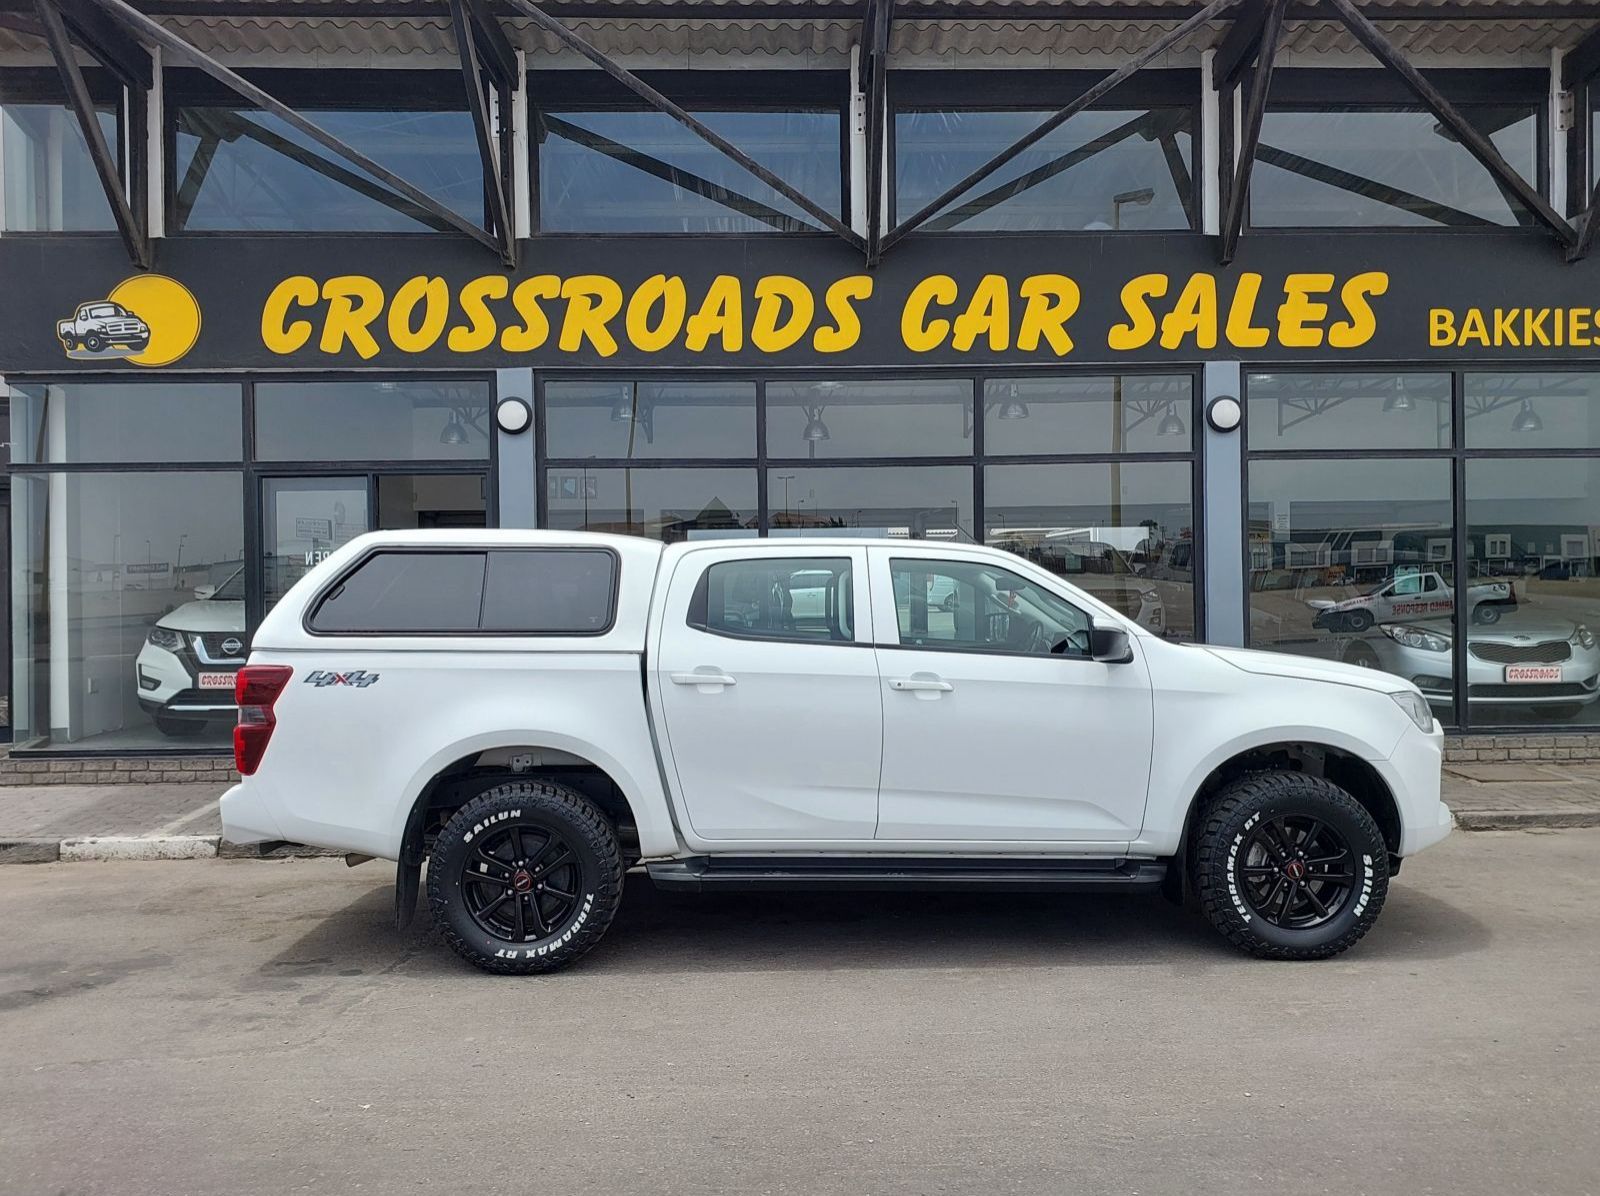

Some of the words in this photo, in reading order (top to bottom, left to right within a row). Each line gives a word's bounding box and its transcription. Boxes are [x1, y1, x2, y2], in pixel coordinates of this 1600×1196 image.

[262, 274, 874, 359] CROSSROADS
[901, 274, 1081, 357] CAR
[1108, 272, 1389, 351] SALES
[1429, 308, 1600, 347] BAKKIE
[1508, 668, 1560, 679] CROSSROADS
[463, 809, 521, 843] SAILUN
[1226, 833, 1252, 924] TERRAMAX
[1244, 811, 1260, 831] RT
[1353, 854, 1374, 918] SAILUN
[525, 893, 594, 958] TERRAMAX
[495, 948, 518, 959] RT
